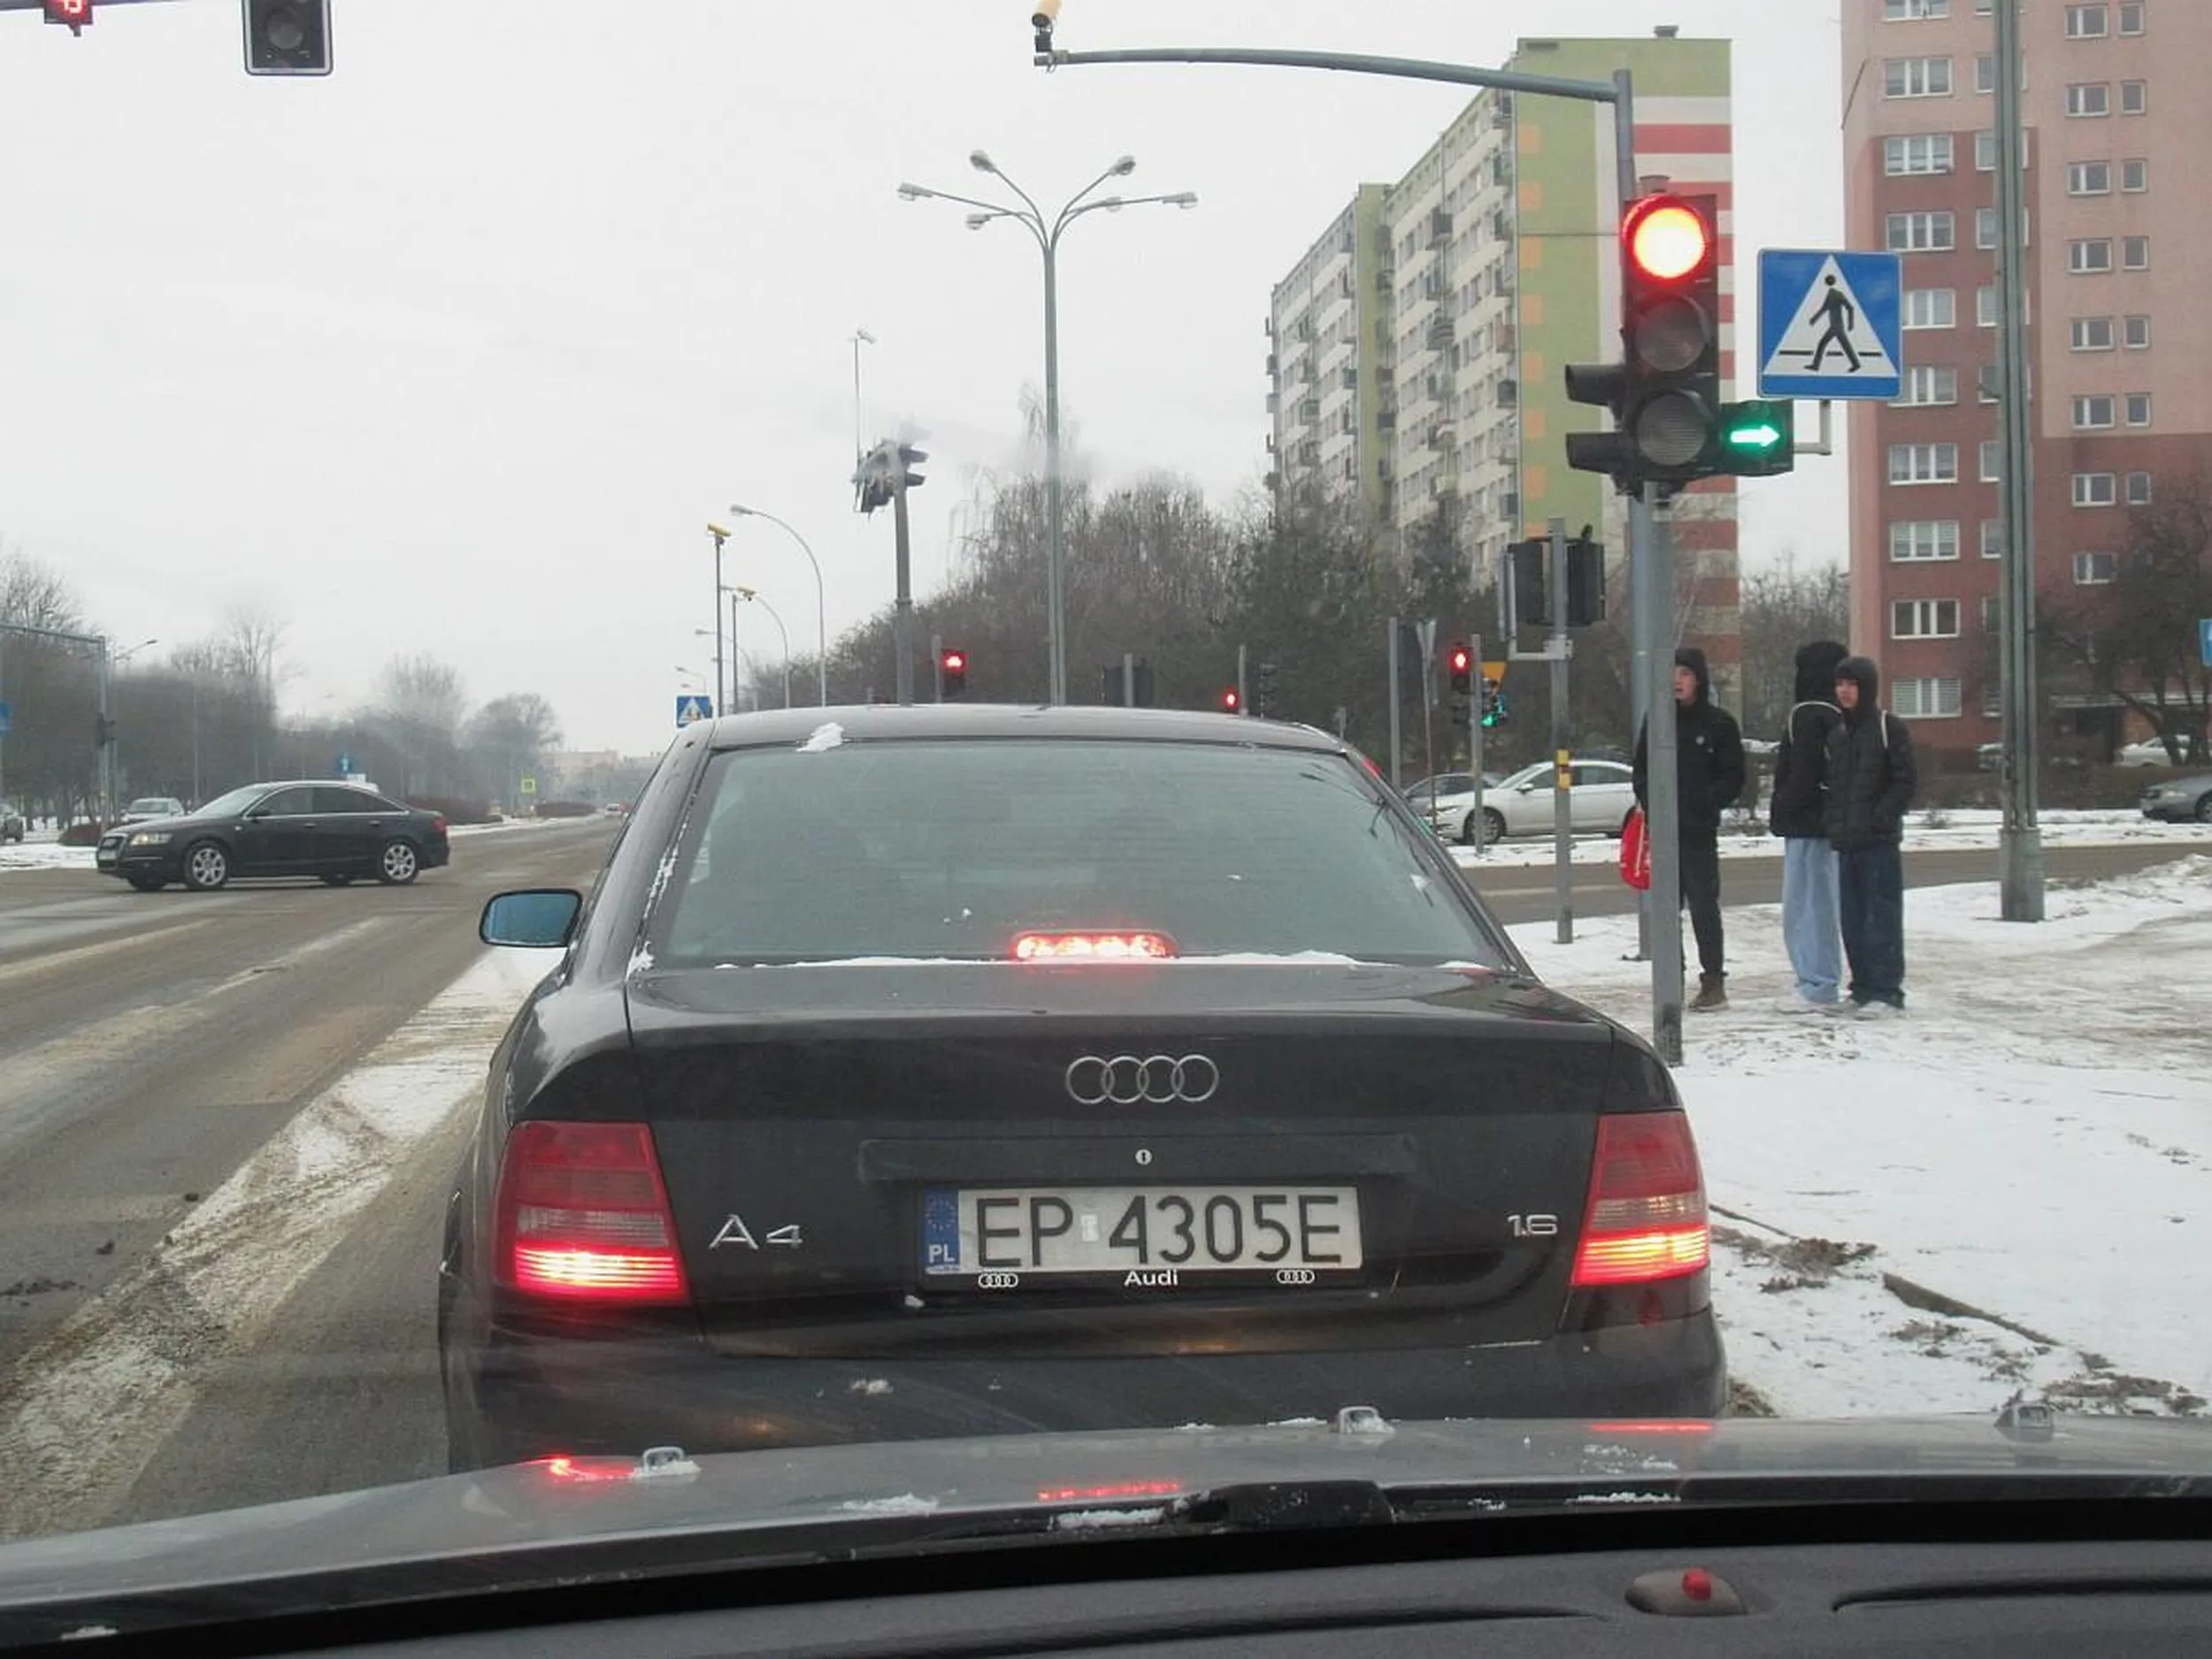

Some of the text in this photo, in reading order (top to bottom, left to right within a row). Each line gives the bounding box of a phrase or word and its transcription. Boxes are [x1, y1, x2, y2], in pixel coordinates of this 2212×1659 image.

[709, 1213, 803, 1250] A4
[976, 1194, 1342, 1267] EP 4305E
[928, 1243, 956, 1263] PL
[1124, 1269, 1179, 1286] Audi
